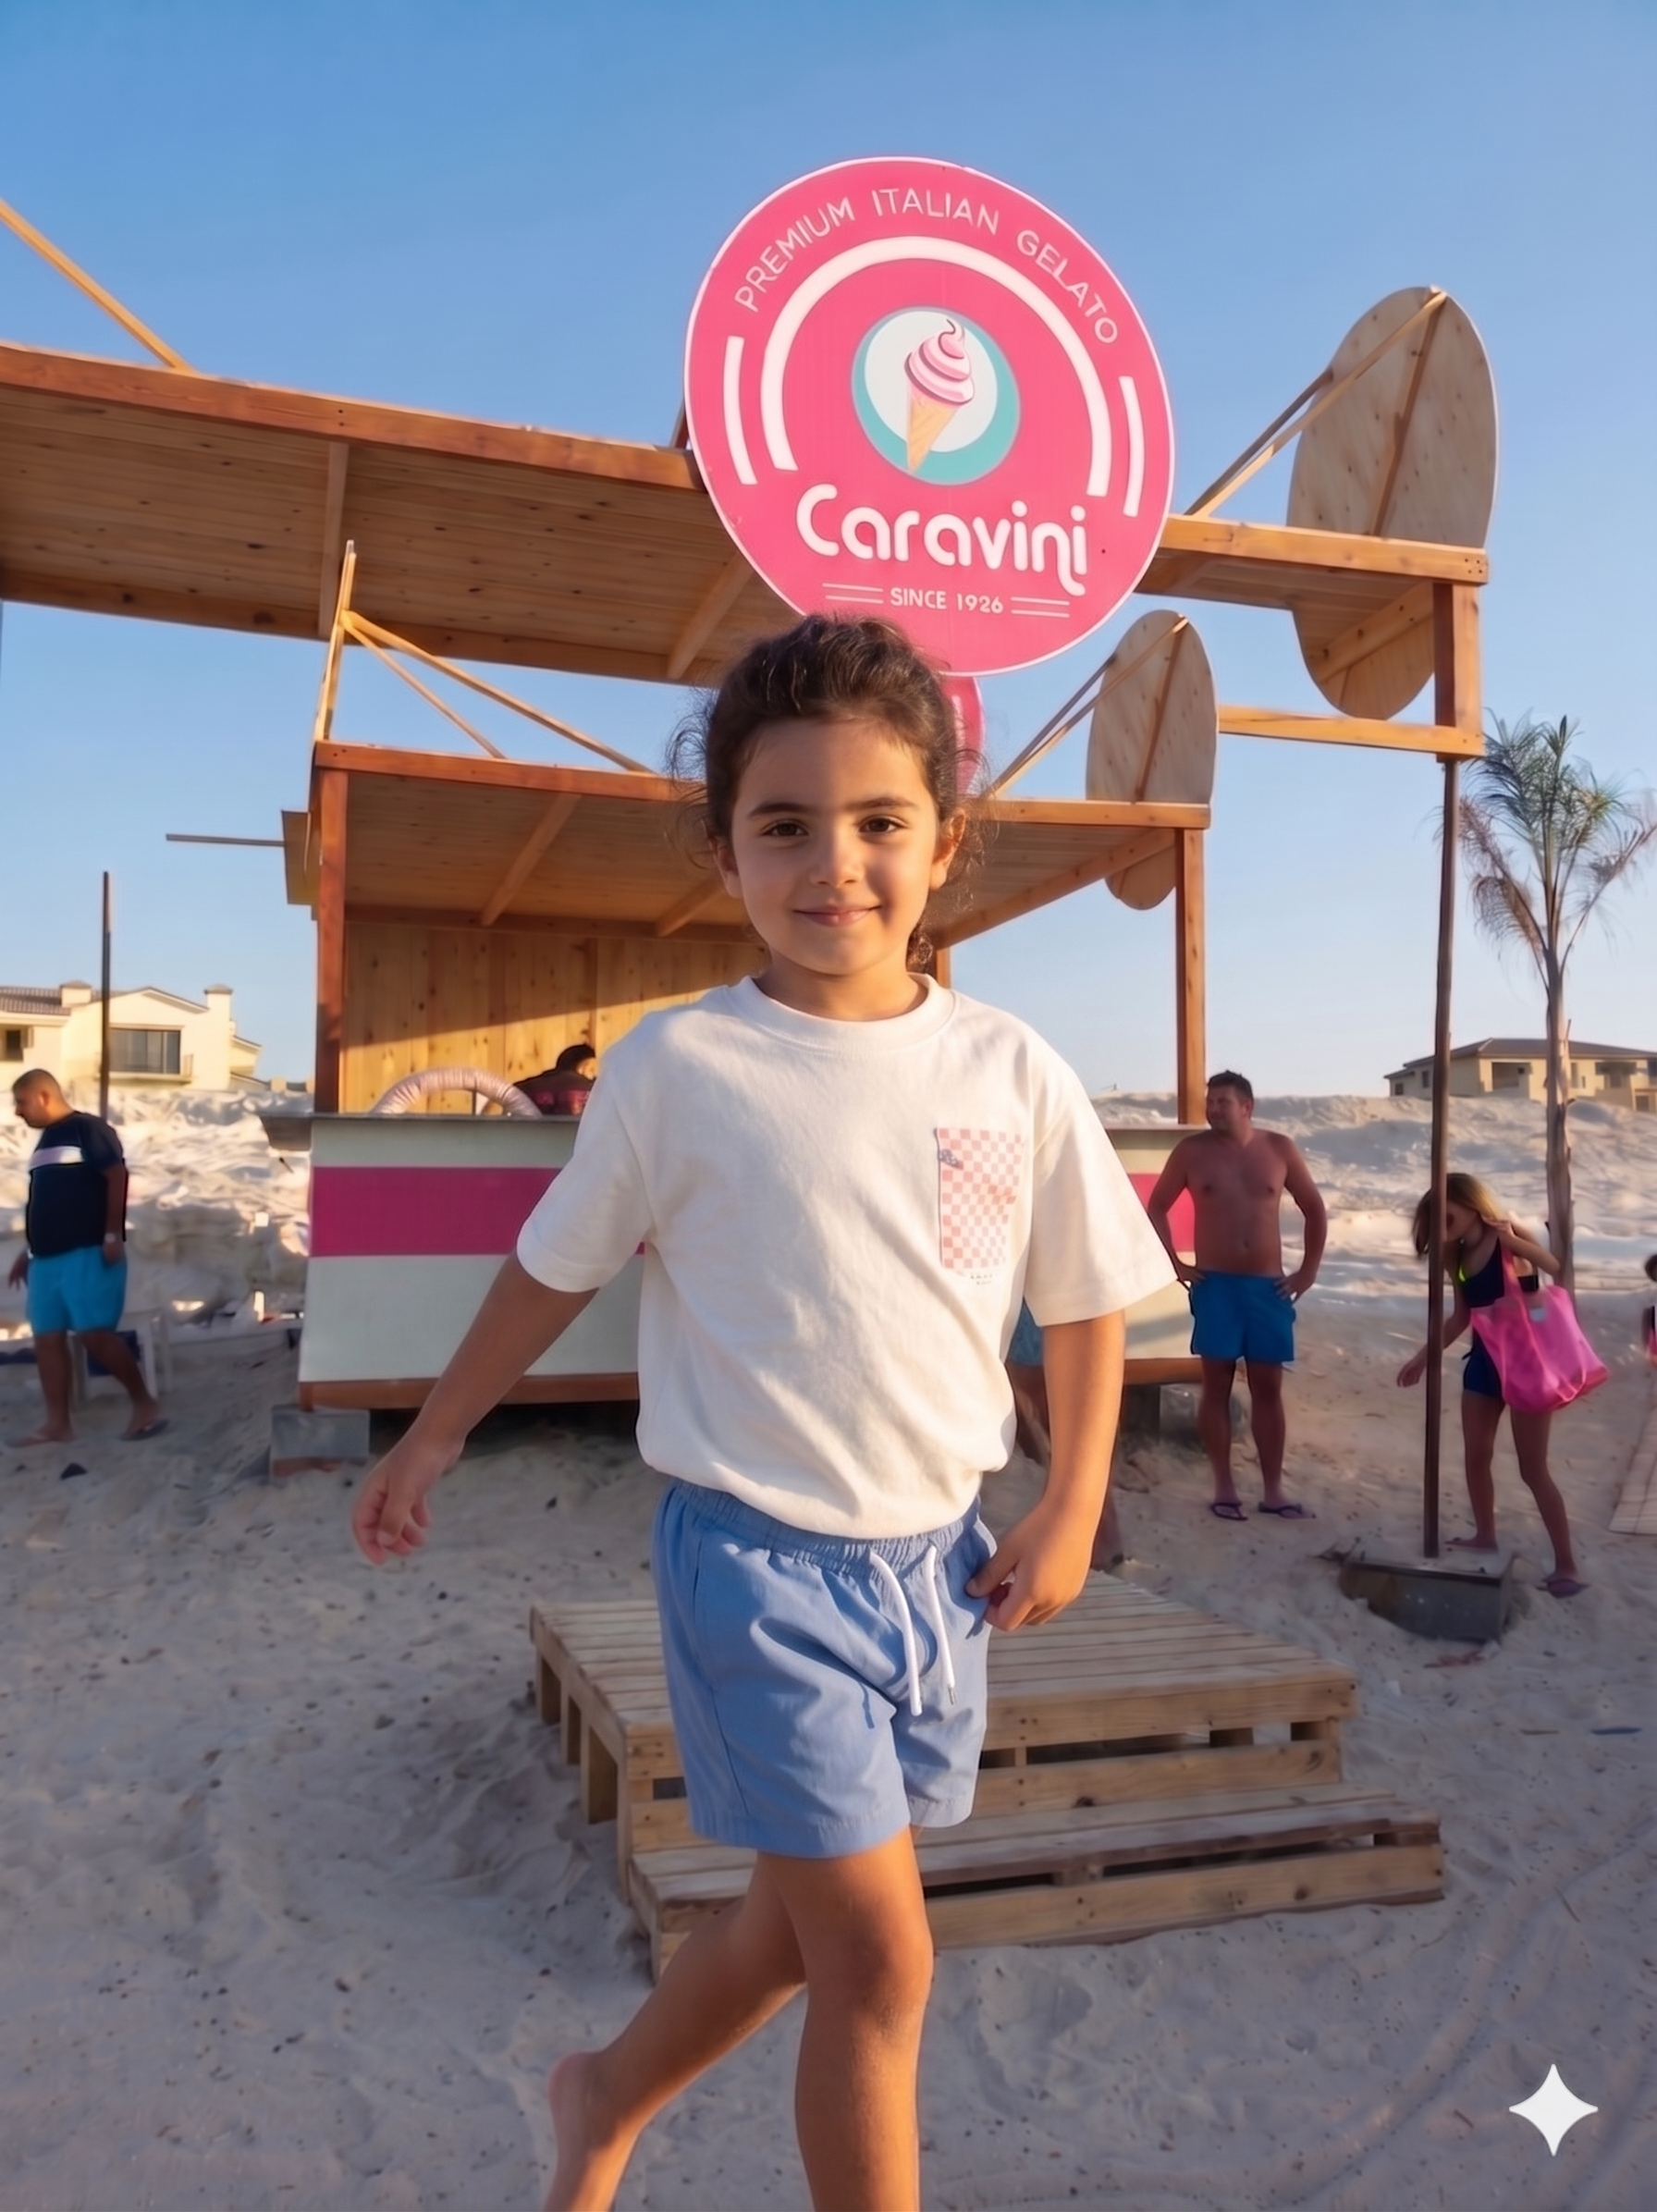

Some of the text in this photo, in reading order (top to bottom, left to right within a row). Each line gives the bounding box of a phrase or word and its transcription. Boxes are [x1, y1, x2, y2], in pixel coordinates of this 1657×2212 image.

[734, 187, 1118, 344] PREMIUM ITALIAN GELATO
[797, 484, 1087, 596] Caravini
[890, 587, 1004, 614] SINCE 1926
